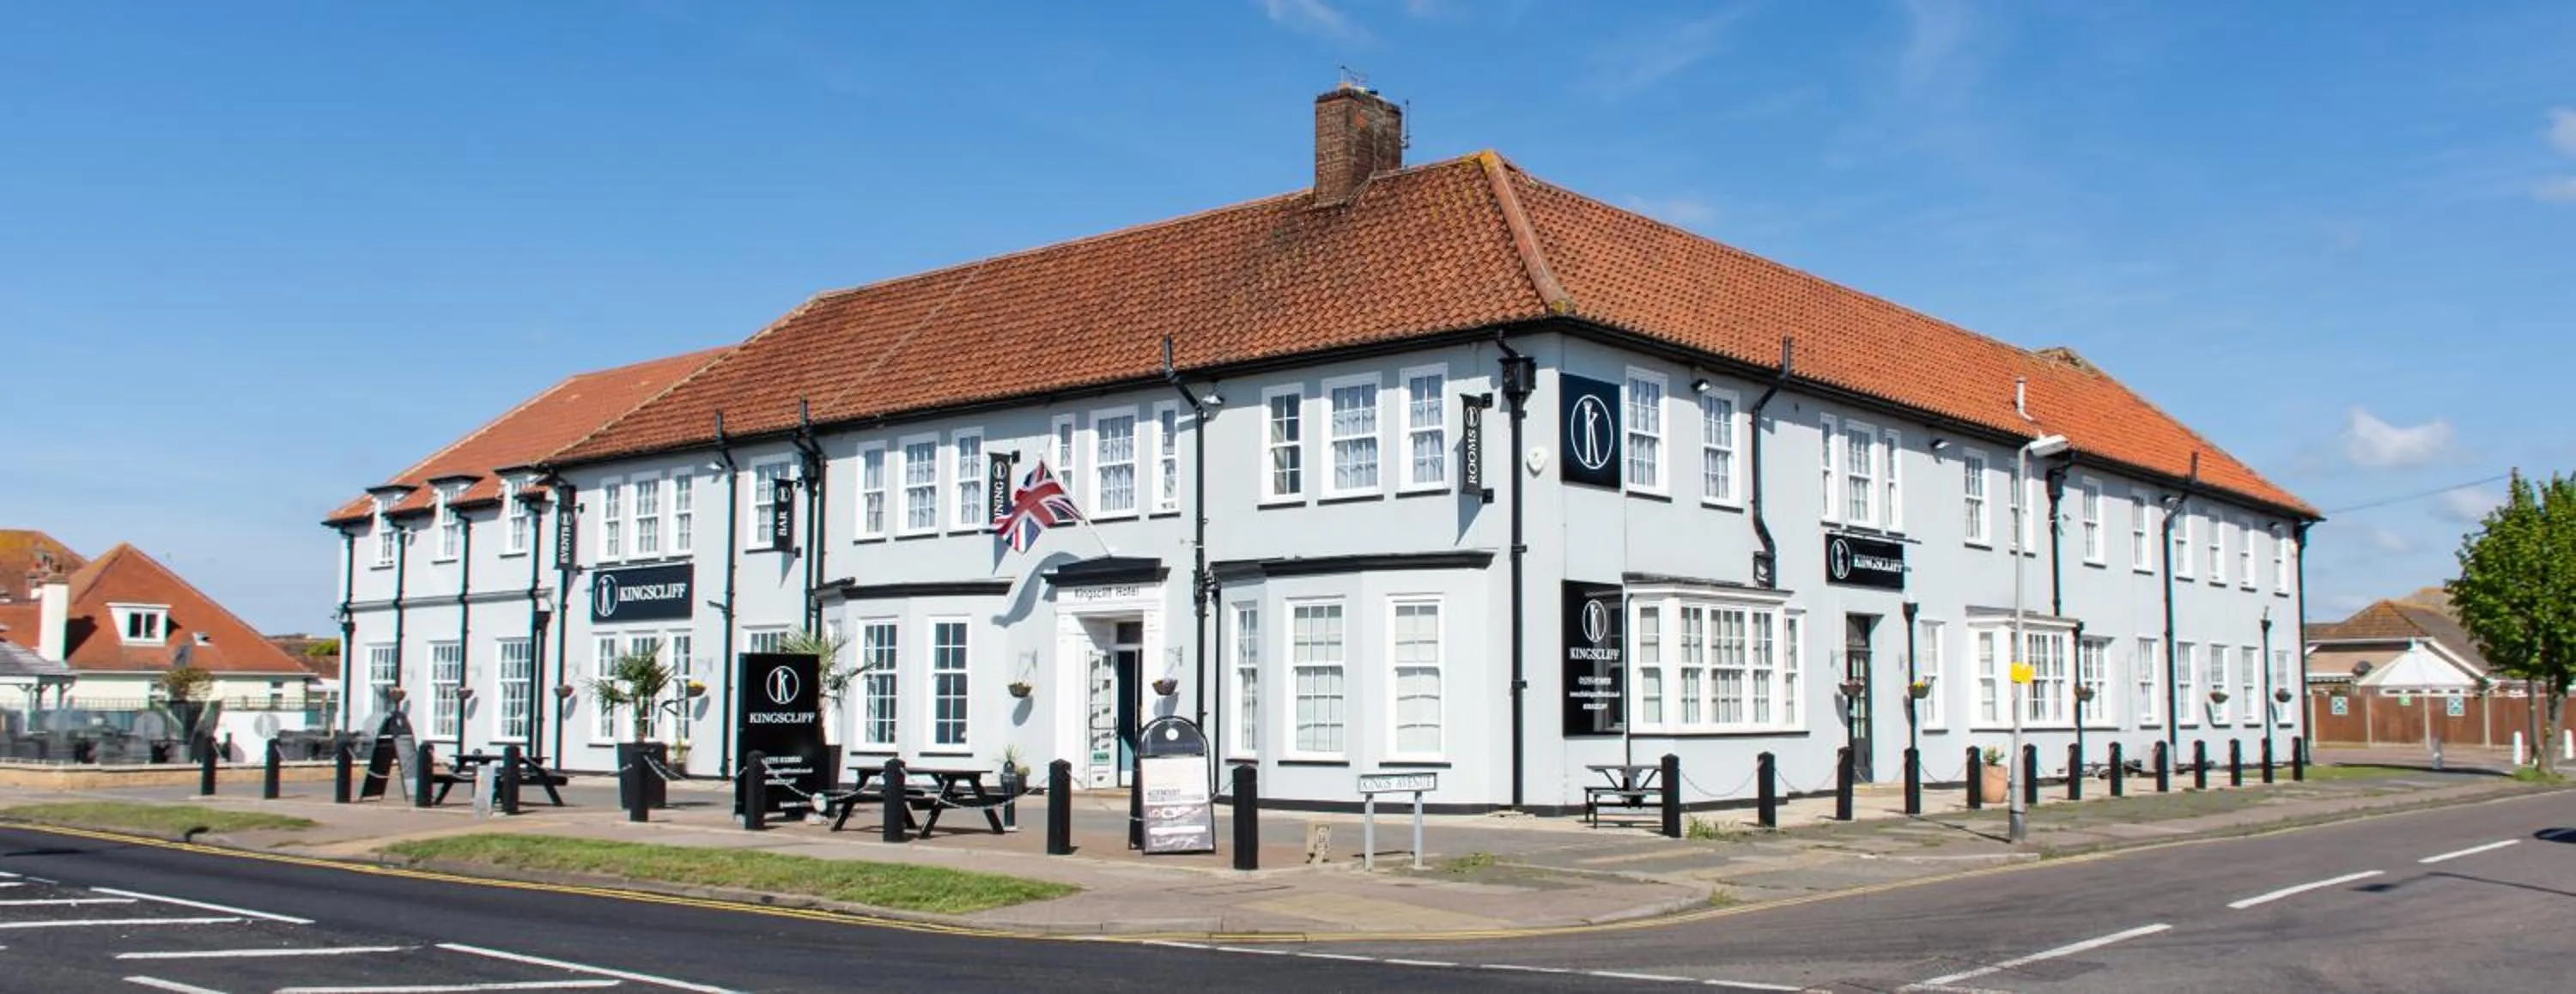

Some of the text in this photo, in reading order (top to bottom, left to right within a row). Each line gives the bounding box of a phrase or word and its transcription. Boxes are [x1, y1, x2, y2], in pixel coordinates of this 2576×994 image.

[1467, 428, 1477, 484] ROOMS
[994, 482, 1004, 516] INING
[777, 511, 787, 536] BAR
[560, 526, 571, 564] EVENTS
[1854, 554, 1902, 573] KINGSCLIFF
[619, 583, 686, 601] KINGSCLIFF
[1116, 585, 1139, 597] Hotel
[1570, 647, 1620, 660] KINGSCLIFF
[749, 712, 815, 724] KINGSCLIFF
[1395, 774, 1432, 790] AVENUE
